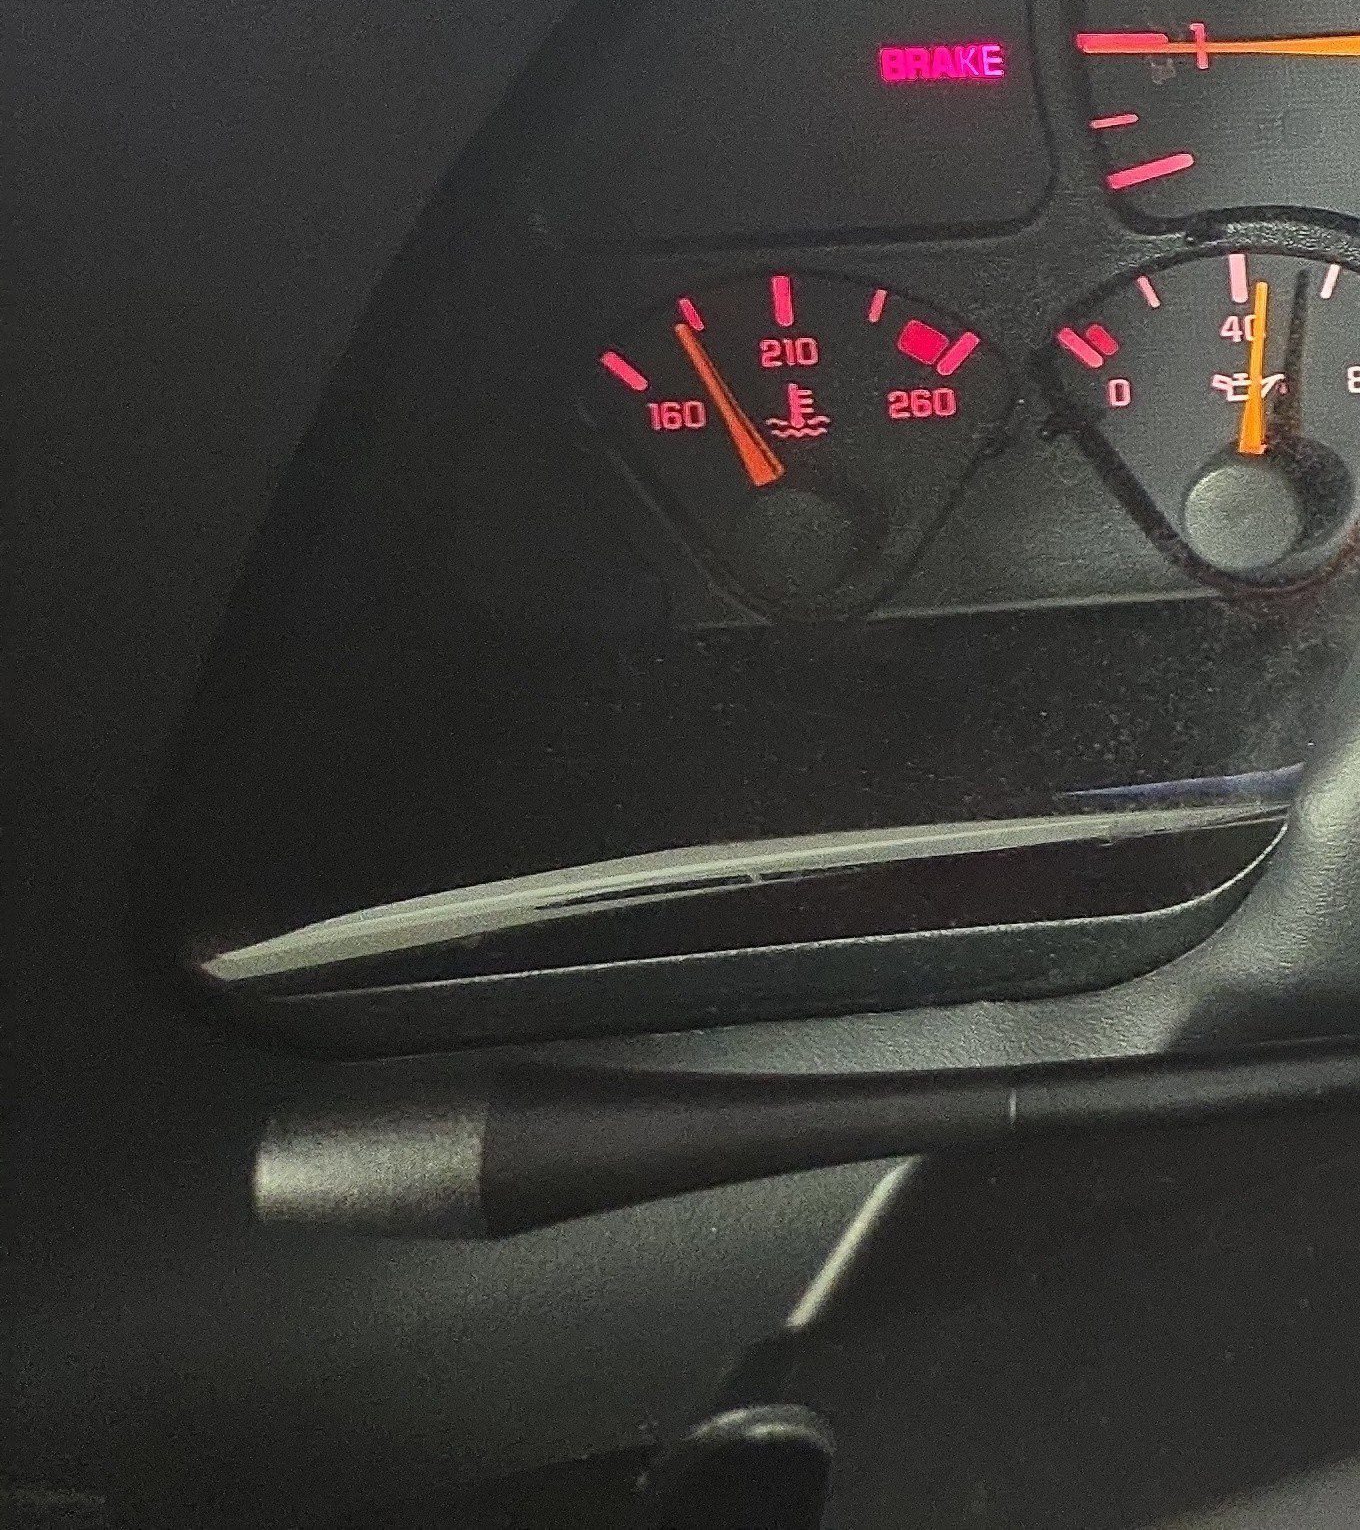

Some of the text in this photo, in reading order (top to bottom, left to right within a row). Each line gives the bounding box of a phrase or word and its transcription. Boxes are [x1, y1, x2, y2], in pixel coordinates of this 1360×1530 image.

[880, 44, 1003, 81] BRAKE
[760, 338, 818, 367] 210
[888, 388, 956, 418] 260
[1108, 379, 1130, 406] 0
[648, 401, 706, 430] 160
